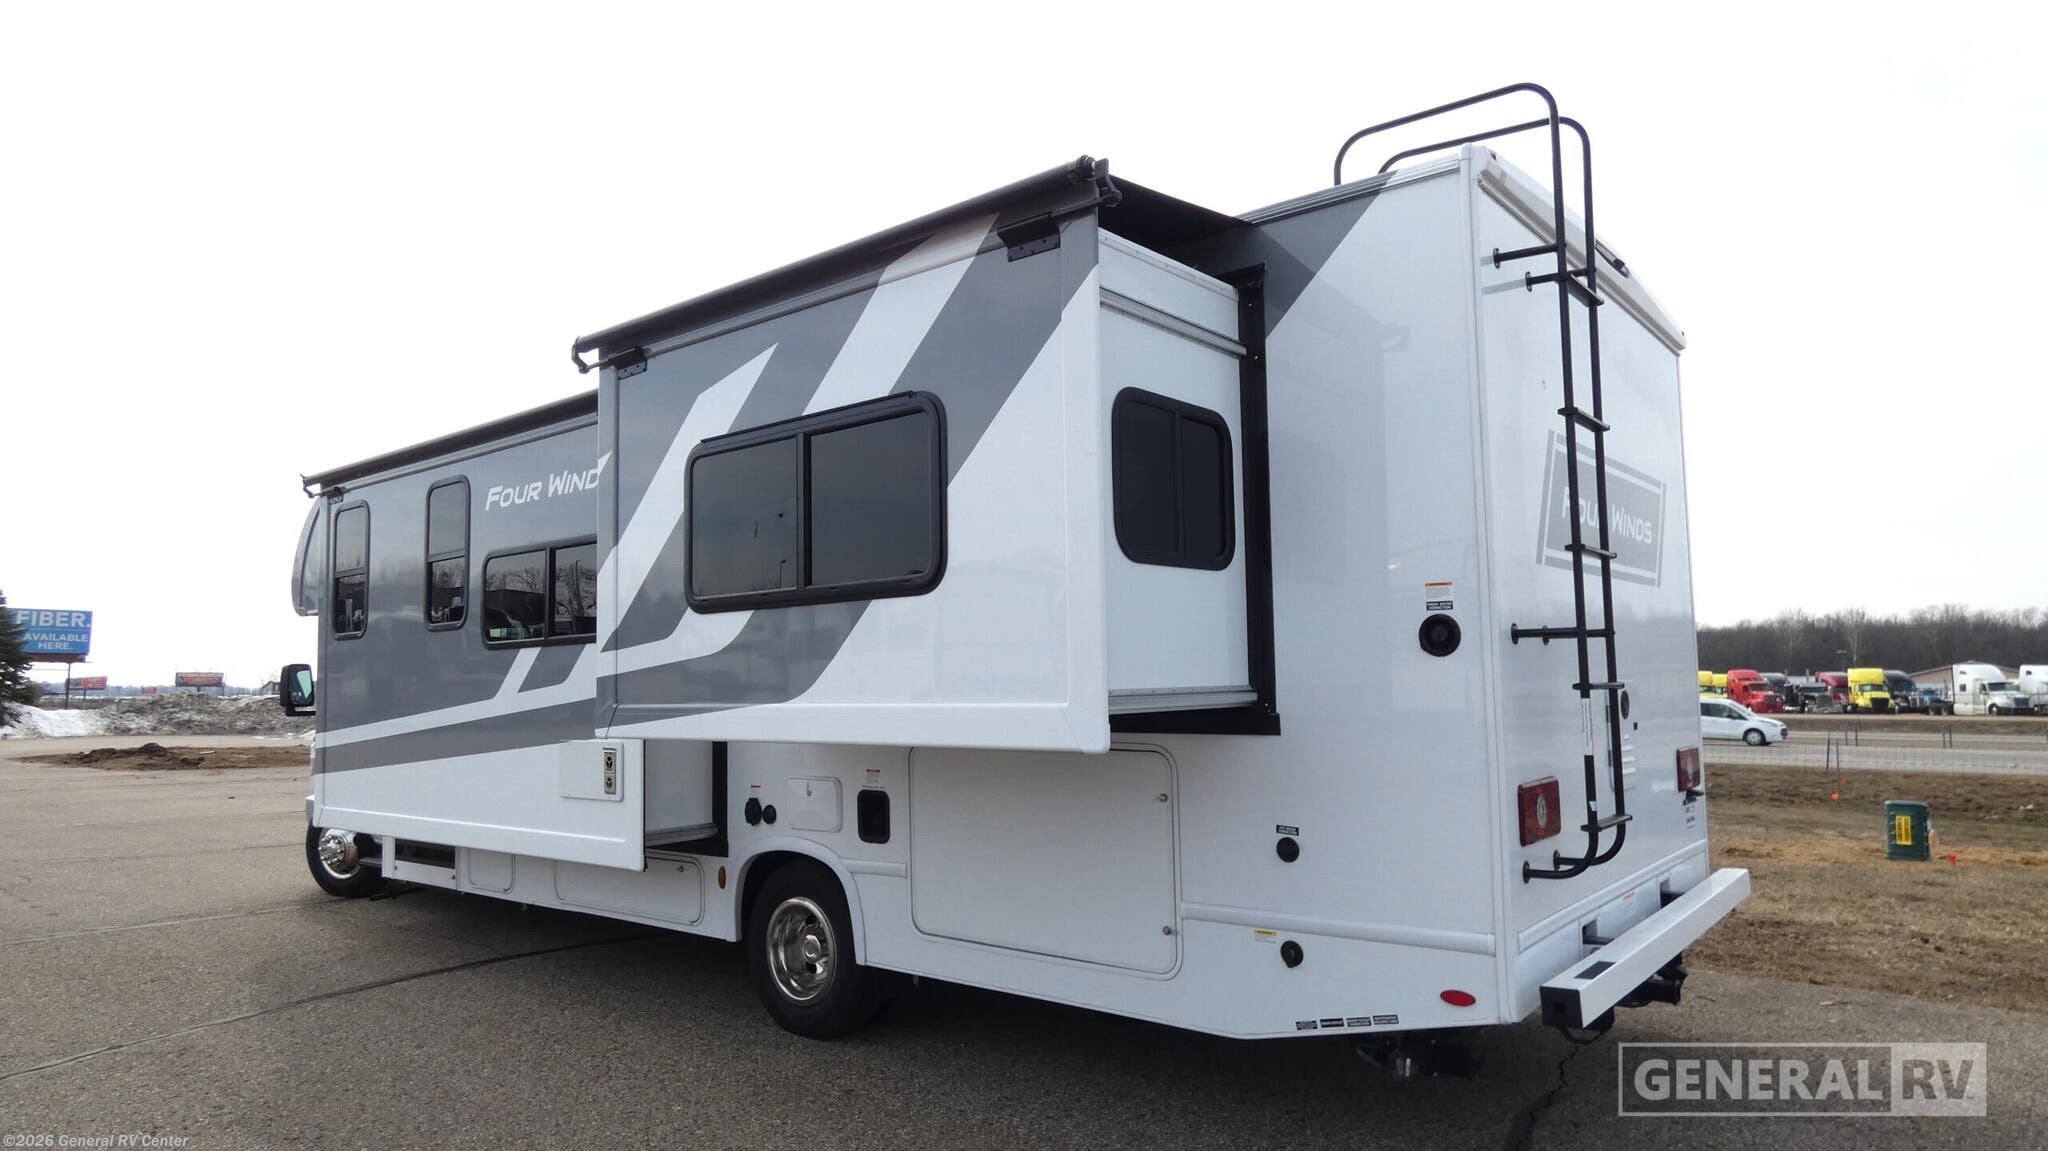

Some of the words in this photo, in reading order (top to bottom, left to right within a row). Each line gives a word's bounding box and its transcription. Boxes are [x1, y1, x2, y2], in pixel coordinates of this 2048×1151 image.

[485, 481, 543, 511] FOUR
[1561, 485, 1600, 530] FOU
[1611, 503, 1653, 545] WINDS
[15, 610, 91, 628] FIBER.
[23, 632, 89, 642] AVAILABLE
[38, 641, 73, 650] HERE.
